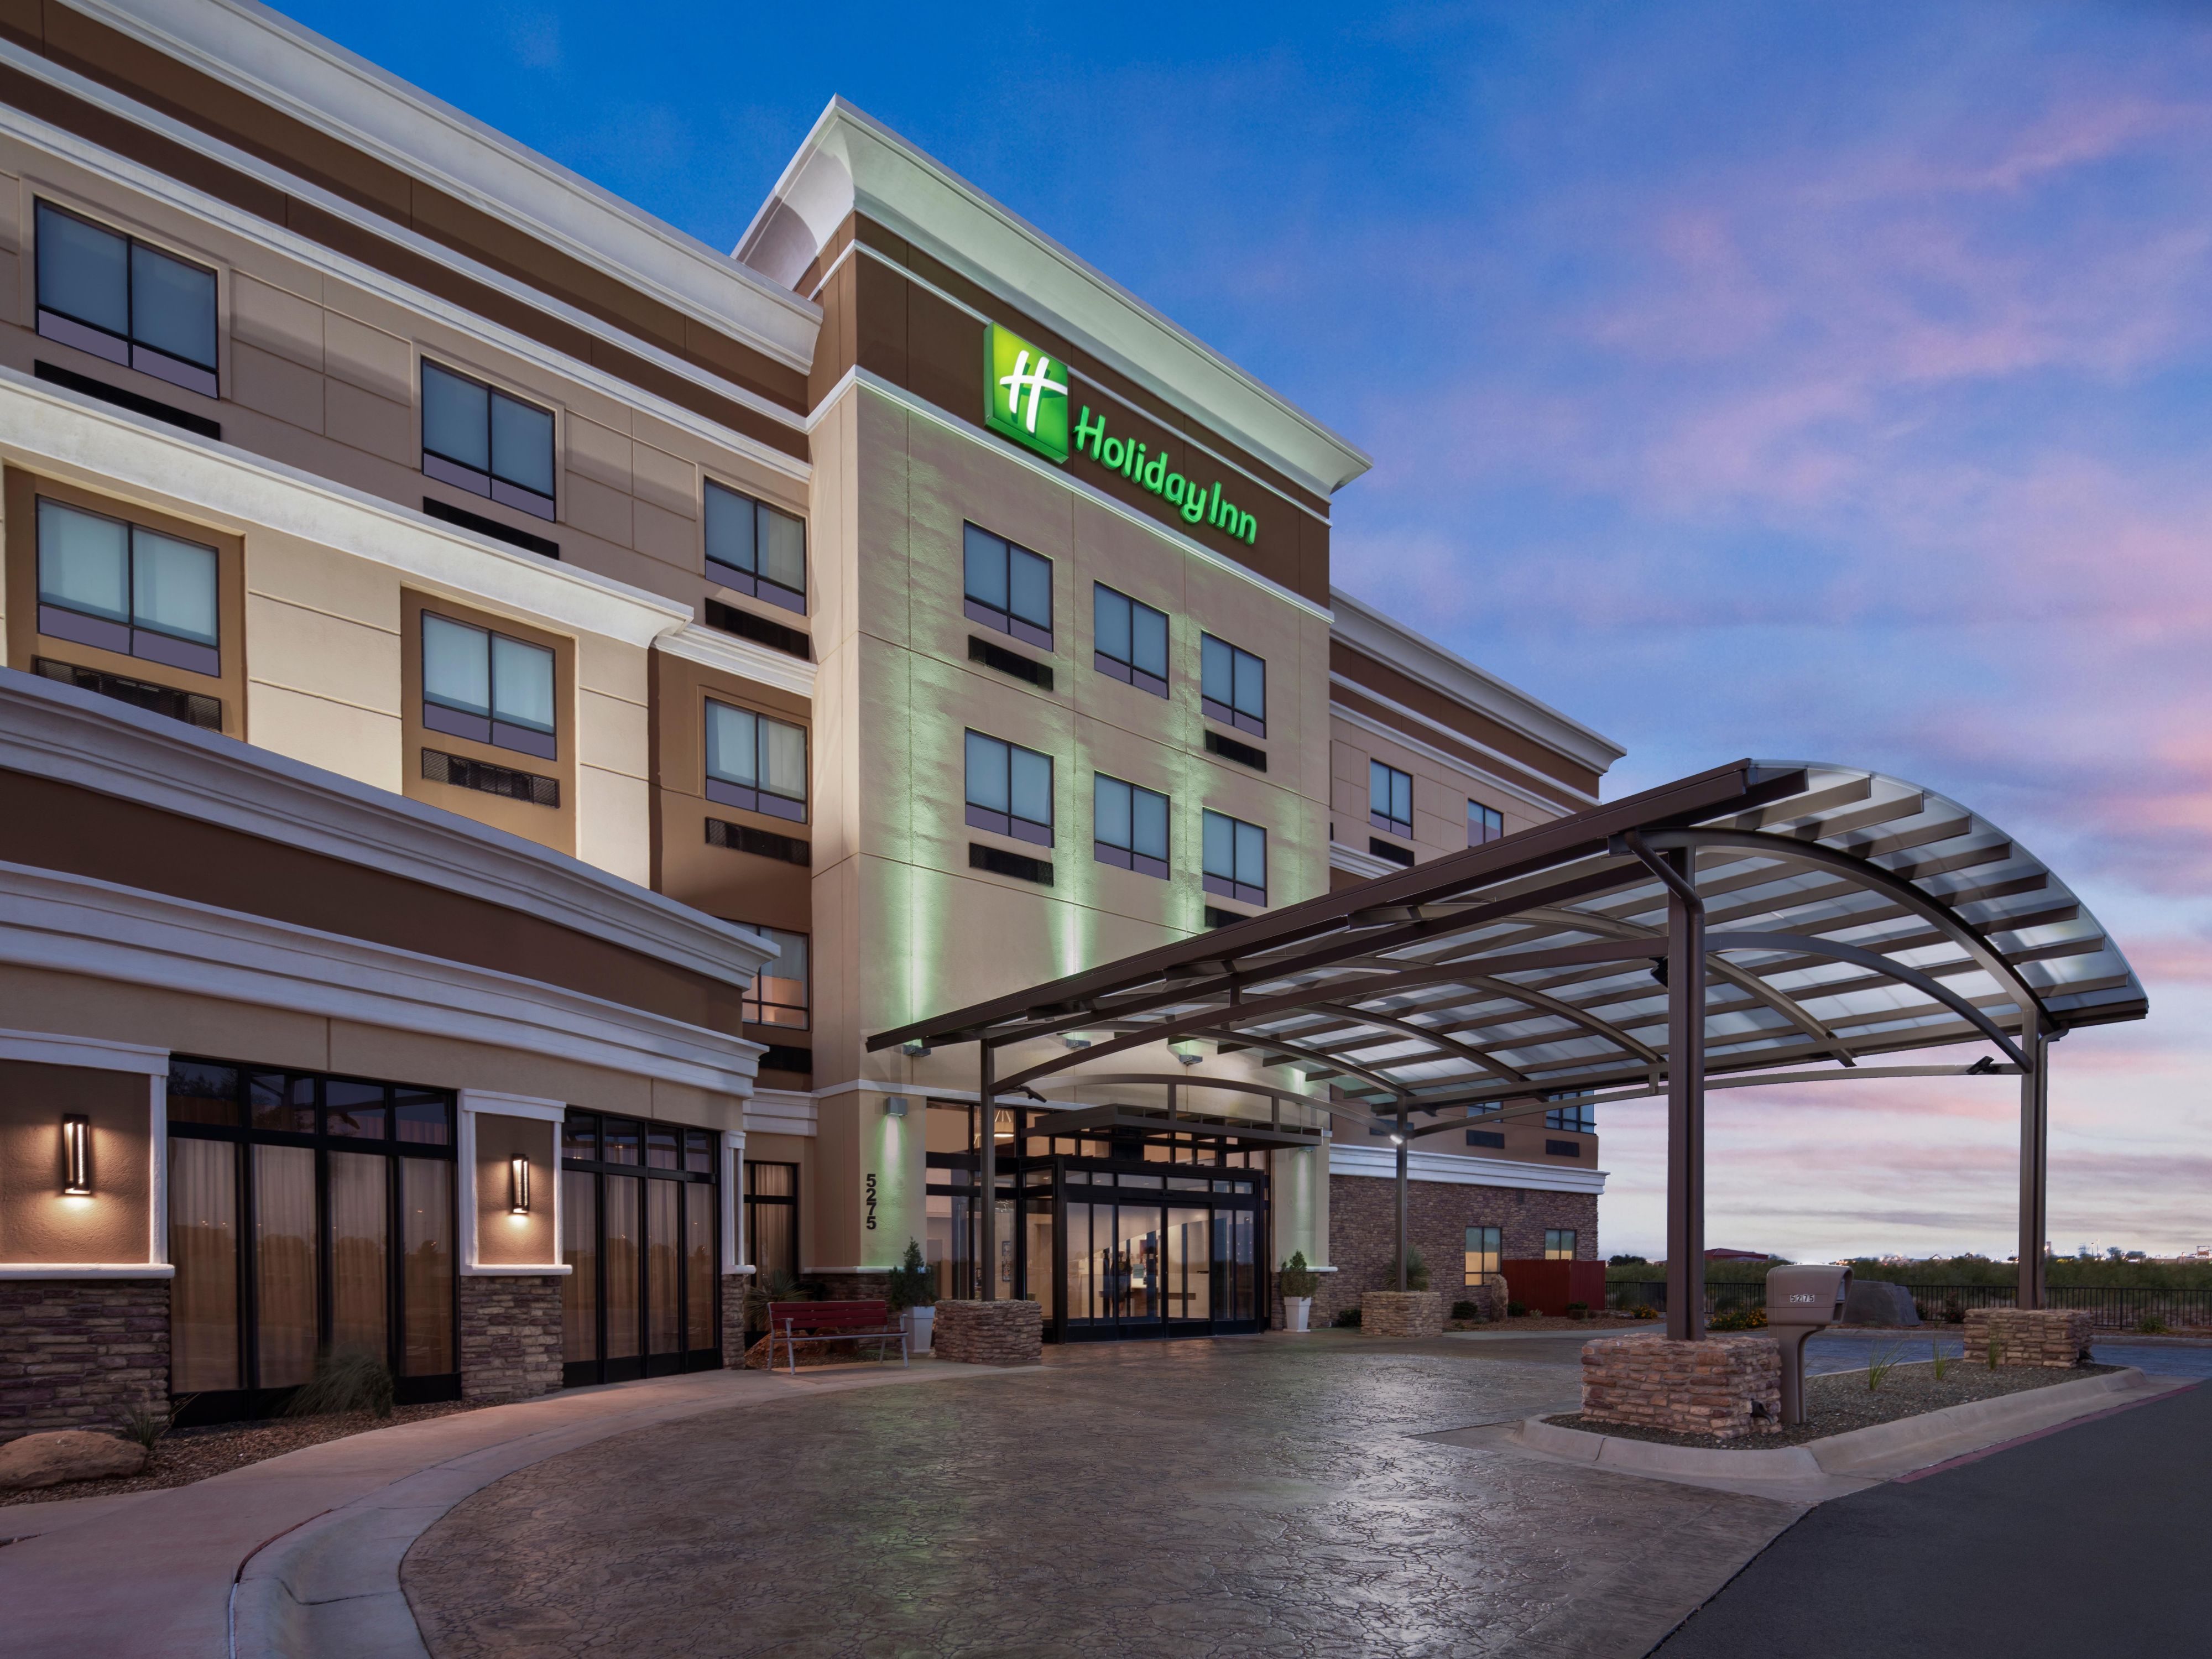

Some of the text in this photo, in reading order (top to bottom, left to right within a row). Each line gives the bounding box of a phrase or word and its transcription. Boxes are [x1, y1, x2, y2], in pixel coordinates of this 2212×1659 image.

[1072, 404, 1258, 545] Holiday Inn
[866, 1173, 877, 1229] 5275
